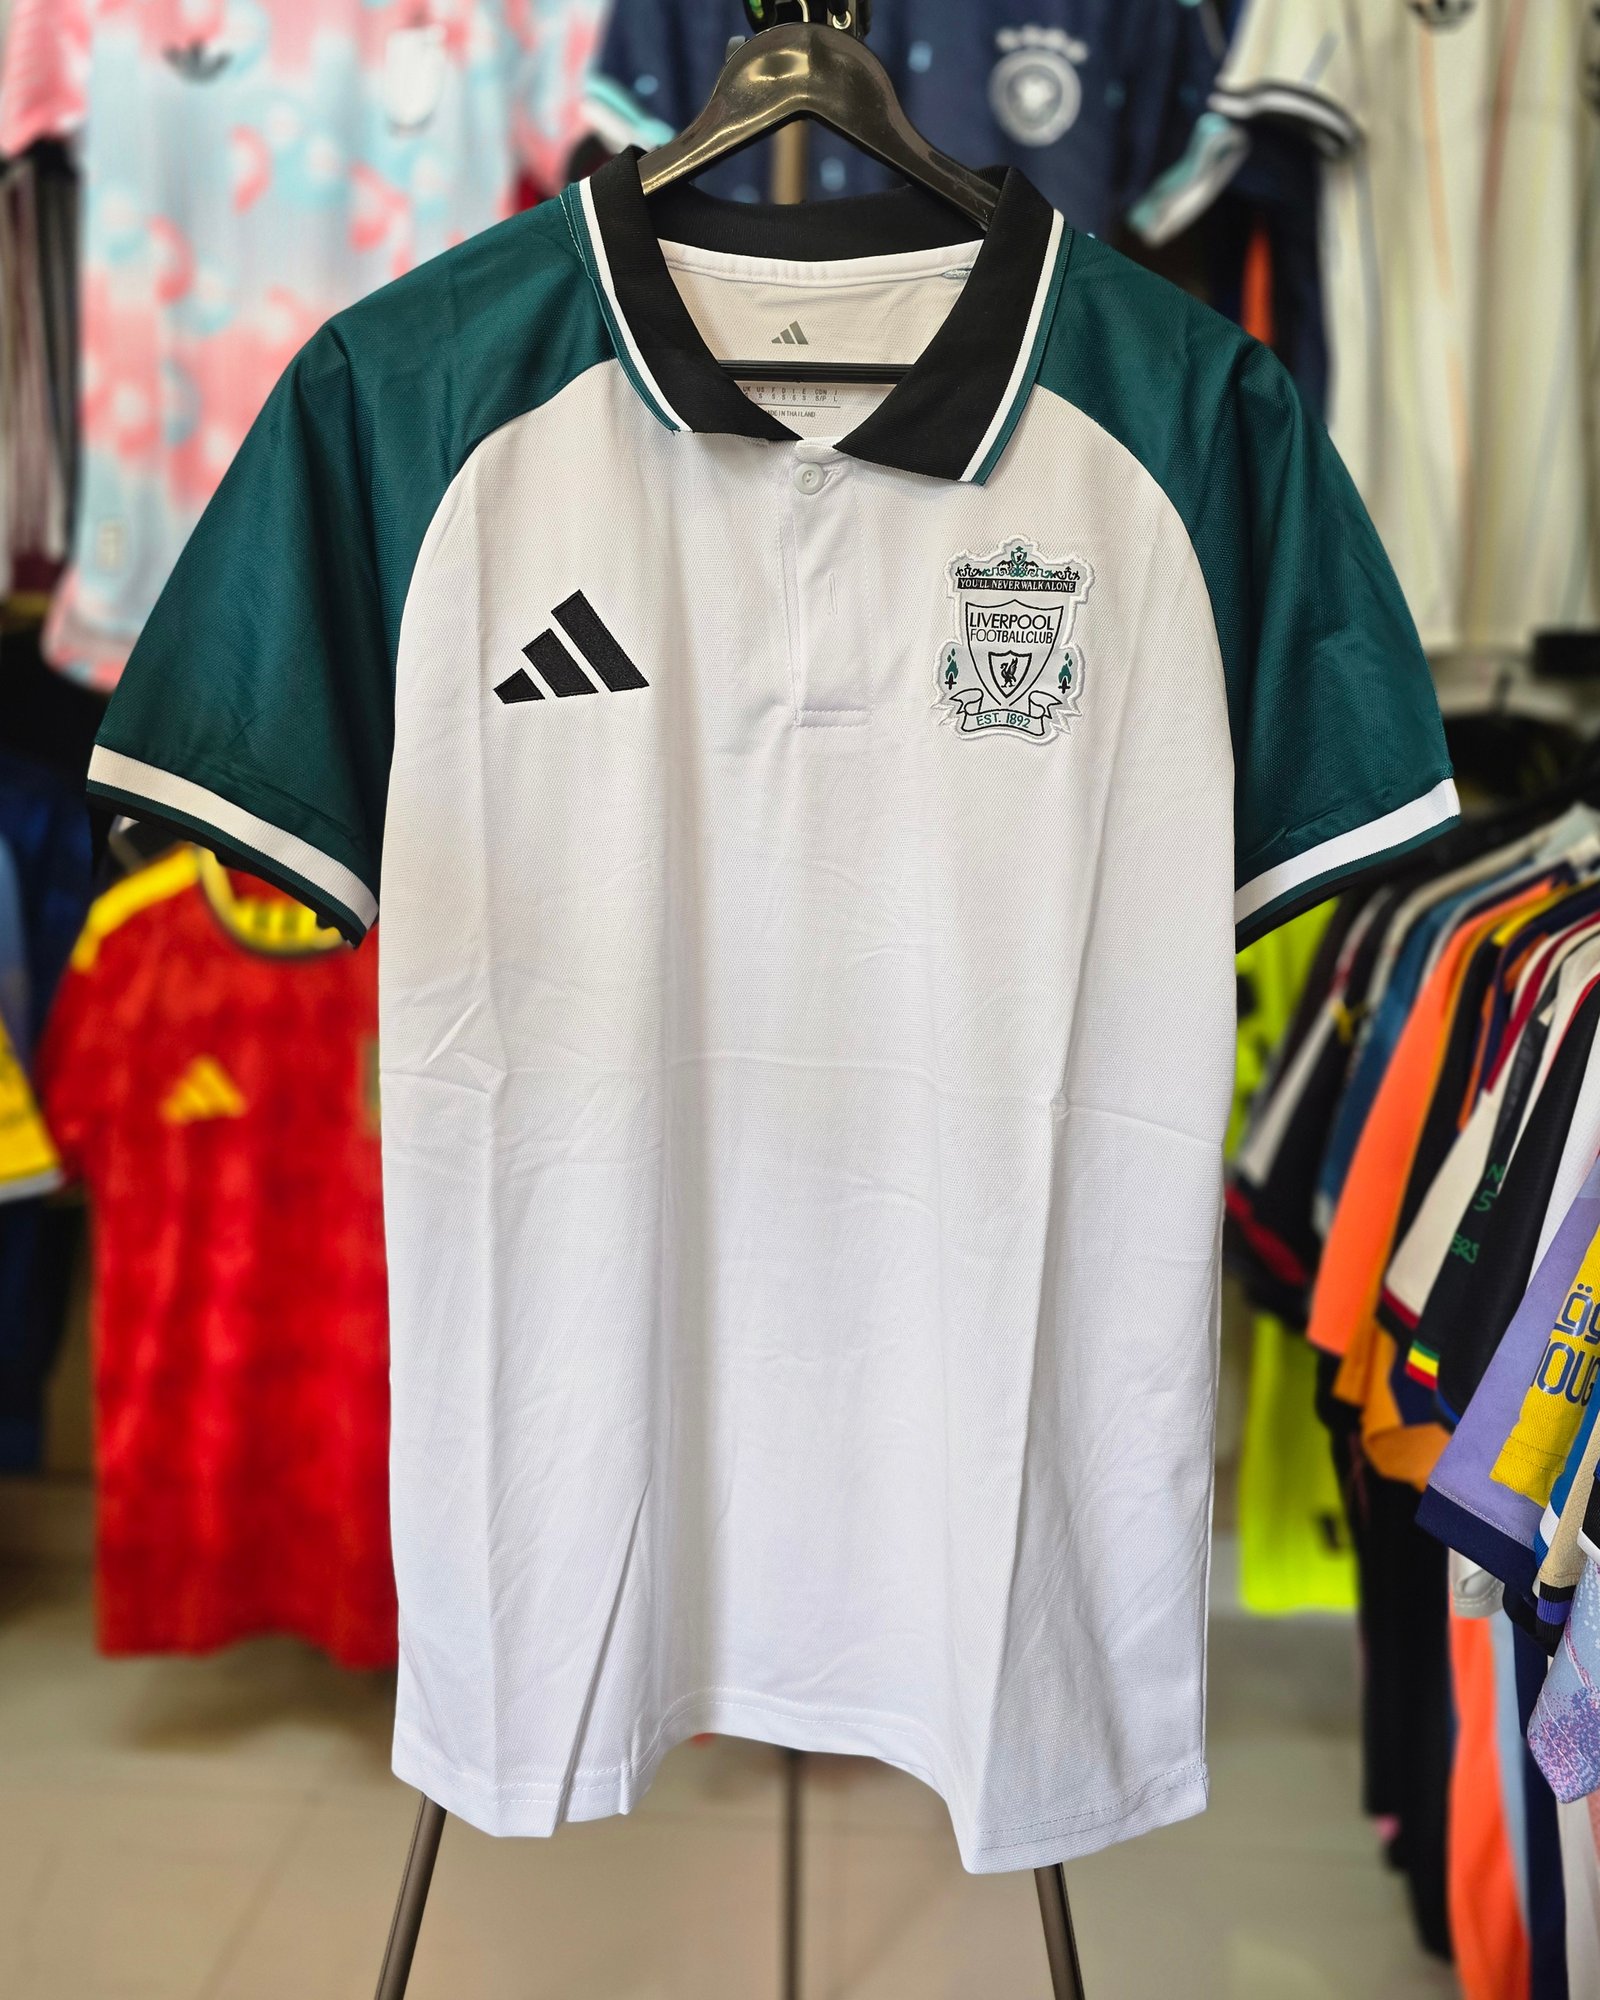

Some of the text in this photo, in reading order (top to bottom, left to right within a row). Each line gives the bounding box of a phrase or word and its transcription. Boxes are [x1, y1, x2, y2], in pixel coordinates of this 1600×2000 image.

[786, 410, 816, 418] THAILAND
[991, 579, 1020, 590] NEVER
[1020, 580, 1046, 591] WALK
[1044, 581, 1075, 592] ALONE
[969, 612, 1055, 630] LIVERPOOL
[976, 712, 1031, 729] EST. 1892
